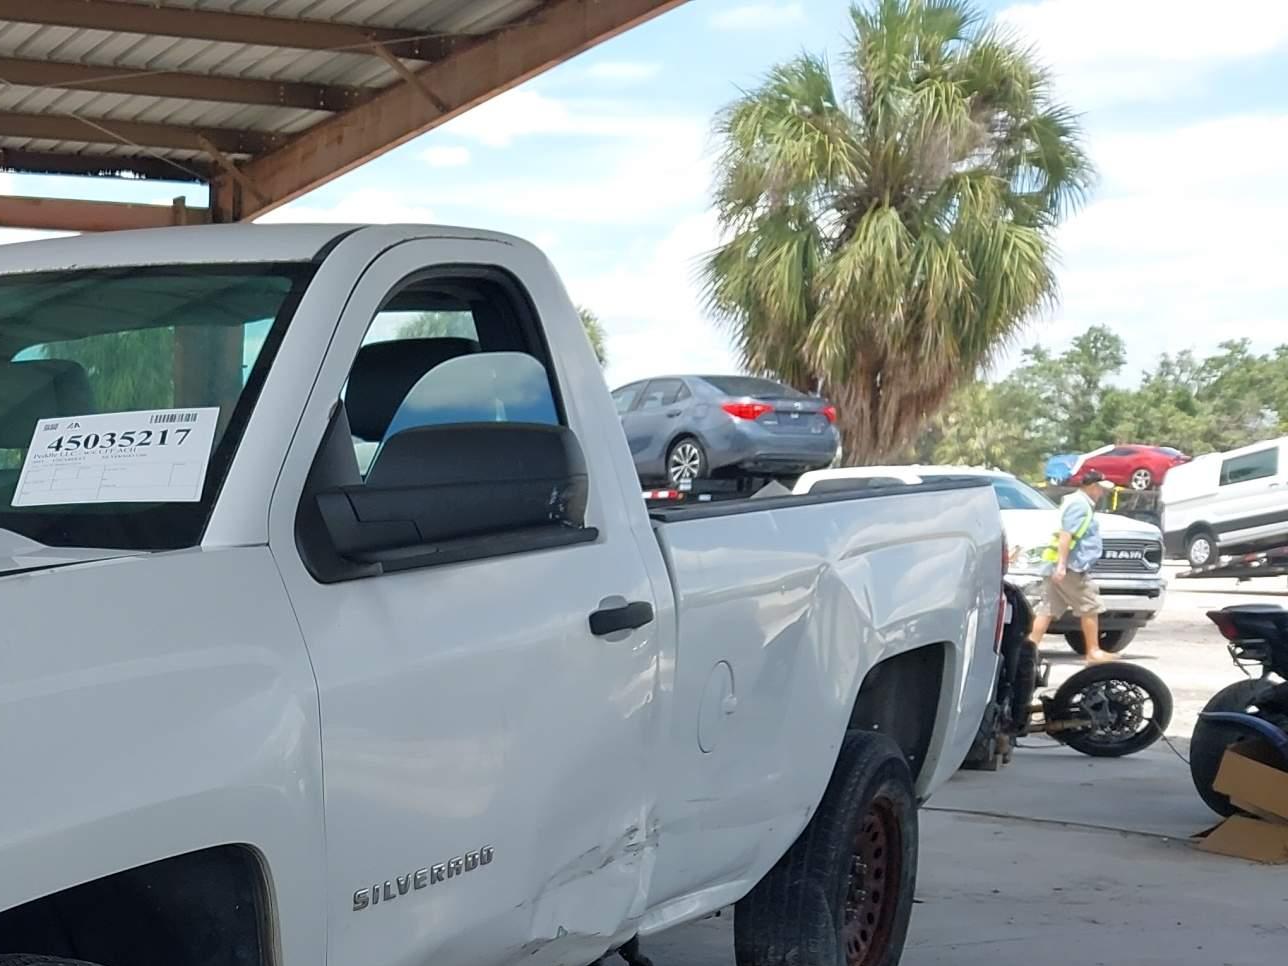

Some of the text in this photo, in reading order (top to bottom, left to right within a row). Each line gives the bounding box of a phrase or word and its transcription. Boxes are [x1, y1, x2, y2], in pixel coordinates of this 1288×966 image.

[47, 428, 193, 452] 45035217
[1105, 550, 1142, 559] RAM
[352, 844, 495, 912] SILVERADO
